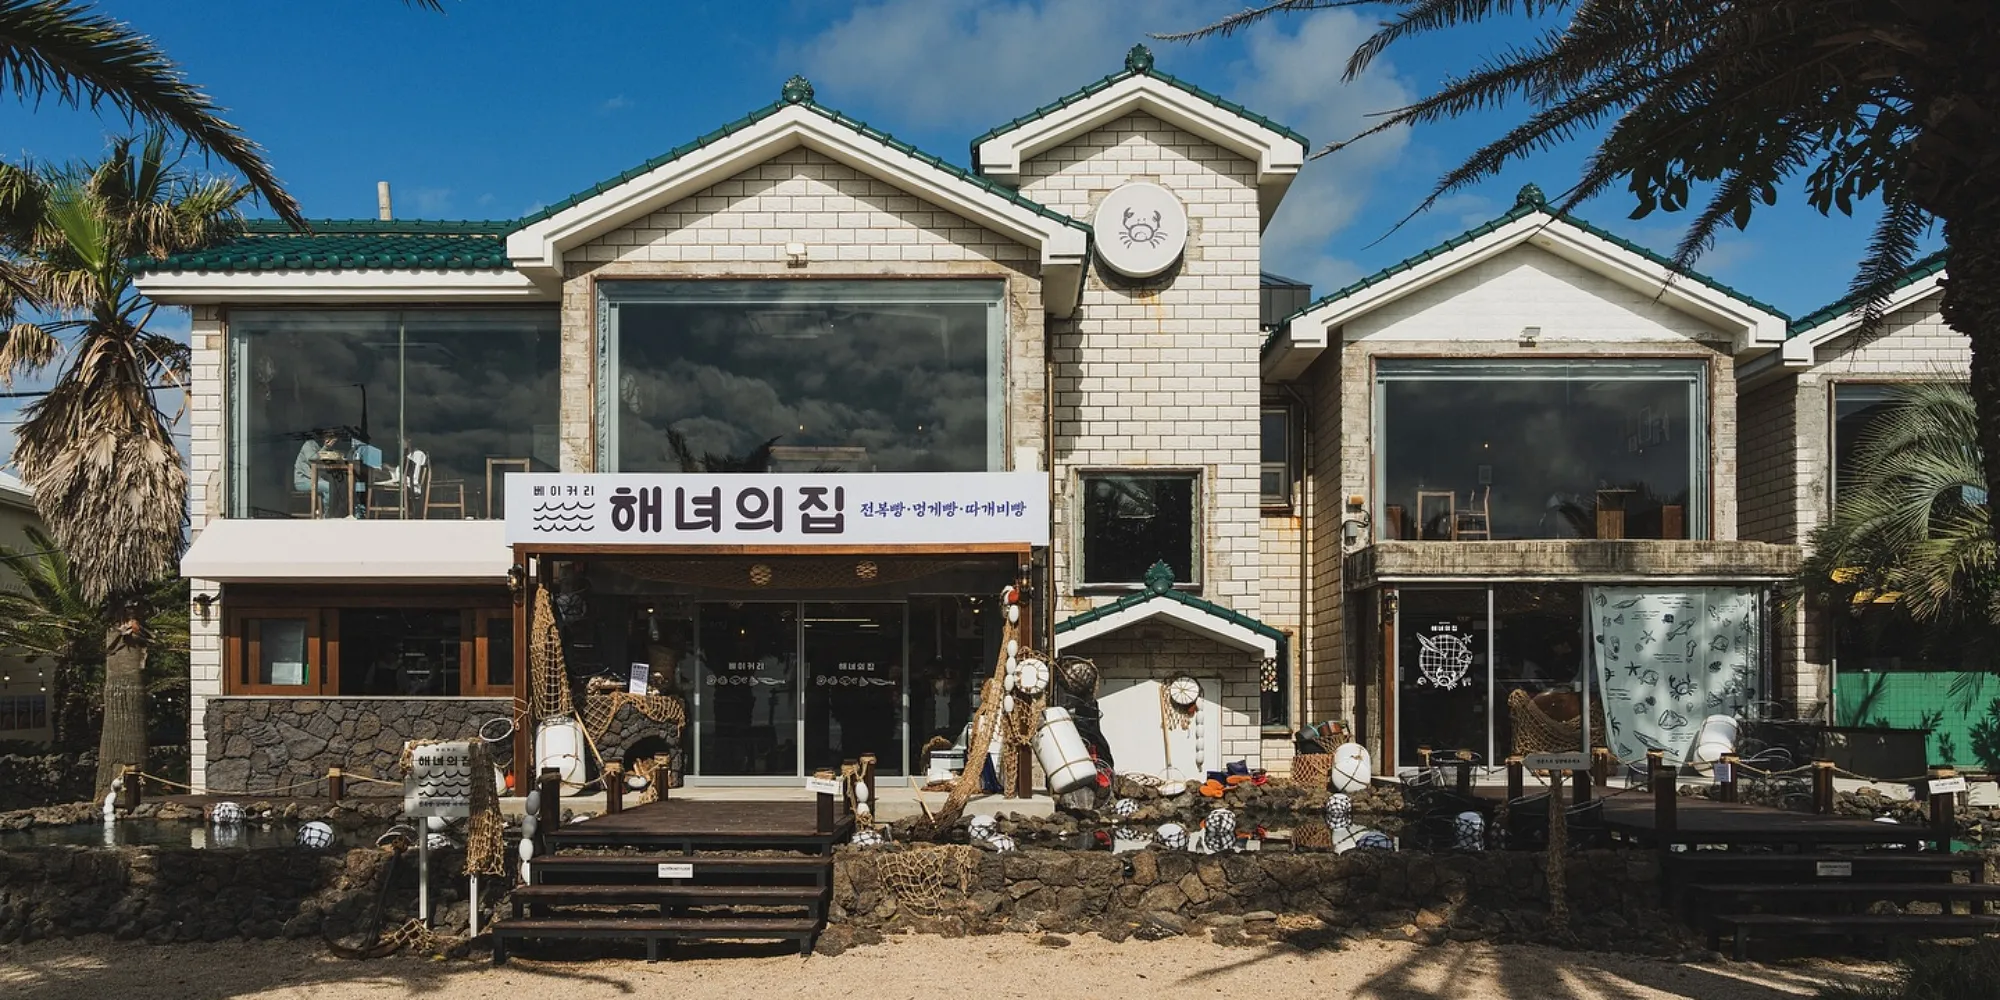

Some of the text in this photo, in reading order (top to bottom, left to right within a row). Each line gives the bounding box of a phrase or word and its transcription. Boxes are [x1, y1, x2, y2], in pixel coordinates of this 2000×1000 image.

[533, 485, 595, 497] 베이커리
[609, 486, 845, 534] 해녀의집
[859, 500, 1027, 518] 전복빵·멍게빵·따개비빵
[728, 662, 765, 671] 베이커리
